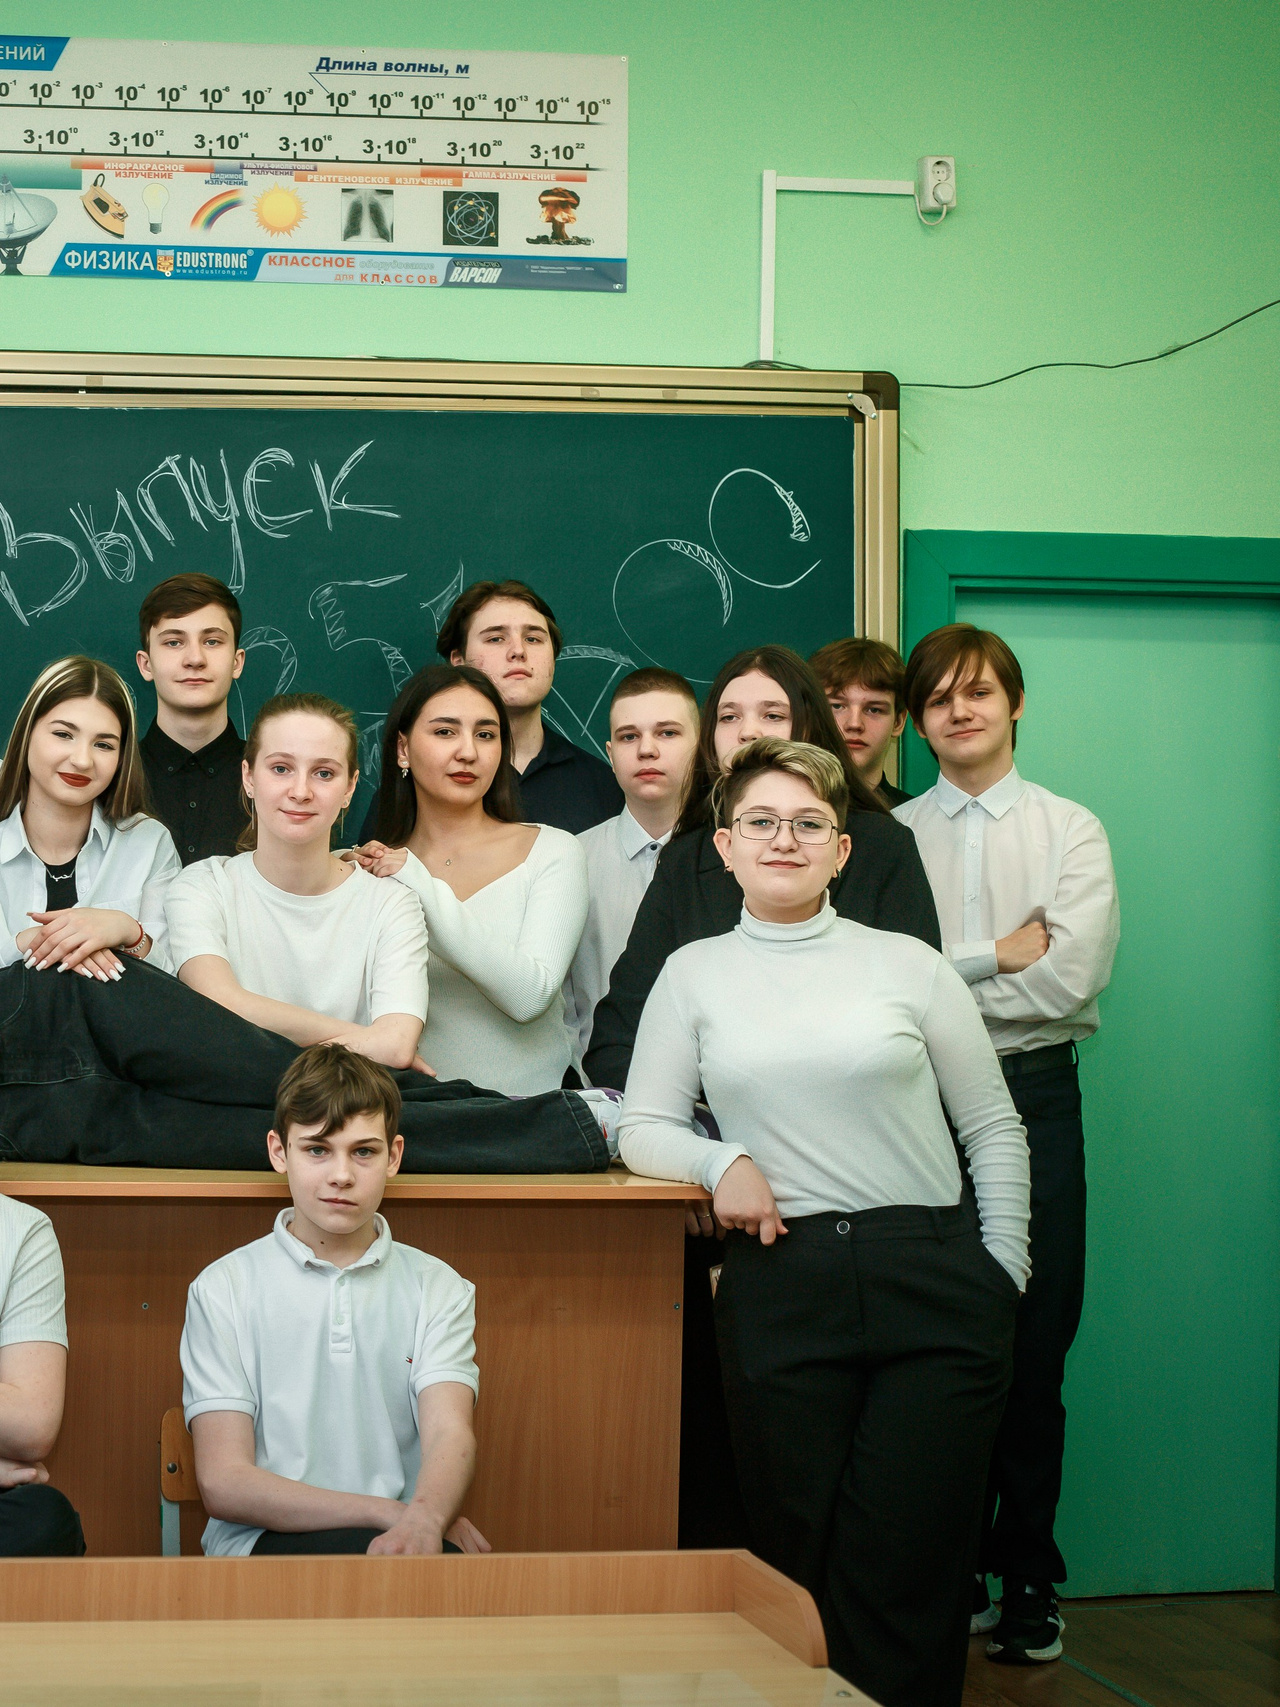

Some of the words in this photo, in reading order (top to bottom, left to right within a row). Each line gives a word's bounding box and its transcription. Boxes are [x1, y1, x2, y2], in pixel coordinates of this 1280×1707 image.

[315, 57, 377, 73] Длина
[383, 60, 449, 76] волны,
[455, 63, 470, 75] м
[104, 162, 185, 172] ИНФРАКРАСНОЕ
[115, 171, 174, 179] ИЗЛУЧЕНИЕ
[307, 174, 390, 184] РЕНТГЕНОВСКОЕ
[395, 177, 453, 186] ИЗЛУЧЕНИЕ
[463, 170, 557, 181] ГАММА-ИЗЛУЧЕНИЕ
[64, 250, 155, 271] ФИЗИКА
[268, 255, 355, 268] КЛАССНОЕ
[454, 260, 501, 268] ИЗДАТЕЛЬСТВО
[176, 268, 248, 276] www.edustrong.ru
[449, 267, 503, 284] ВАРСОН
[334, 273, 354, 282] для
[360, 273, 438, 284] КЛАССОВ
